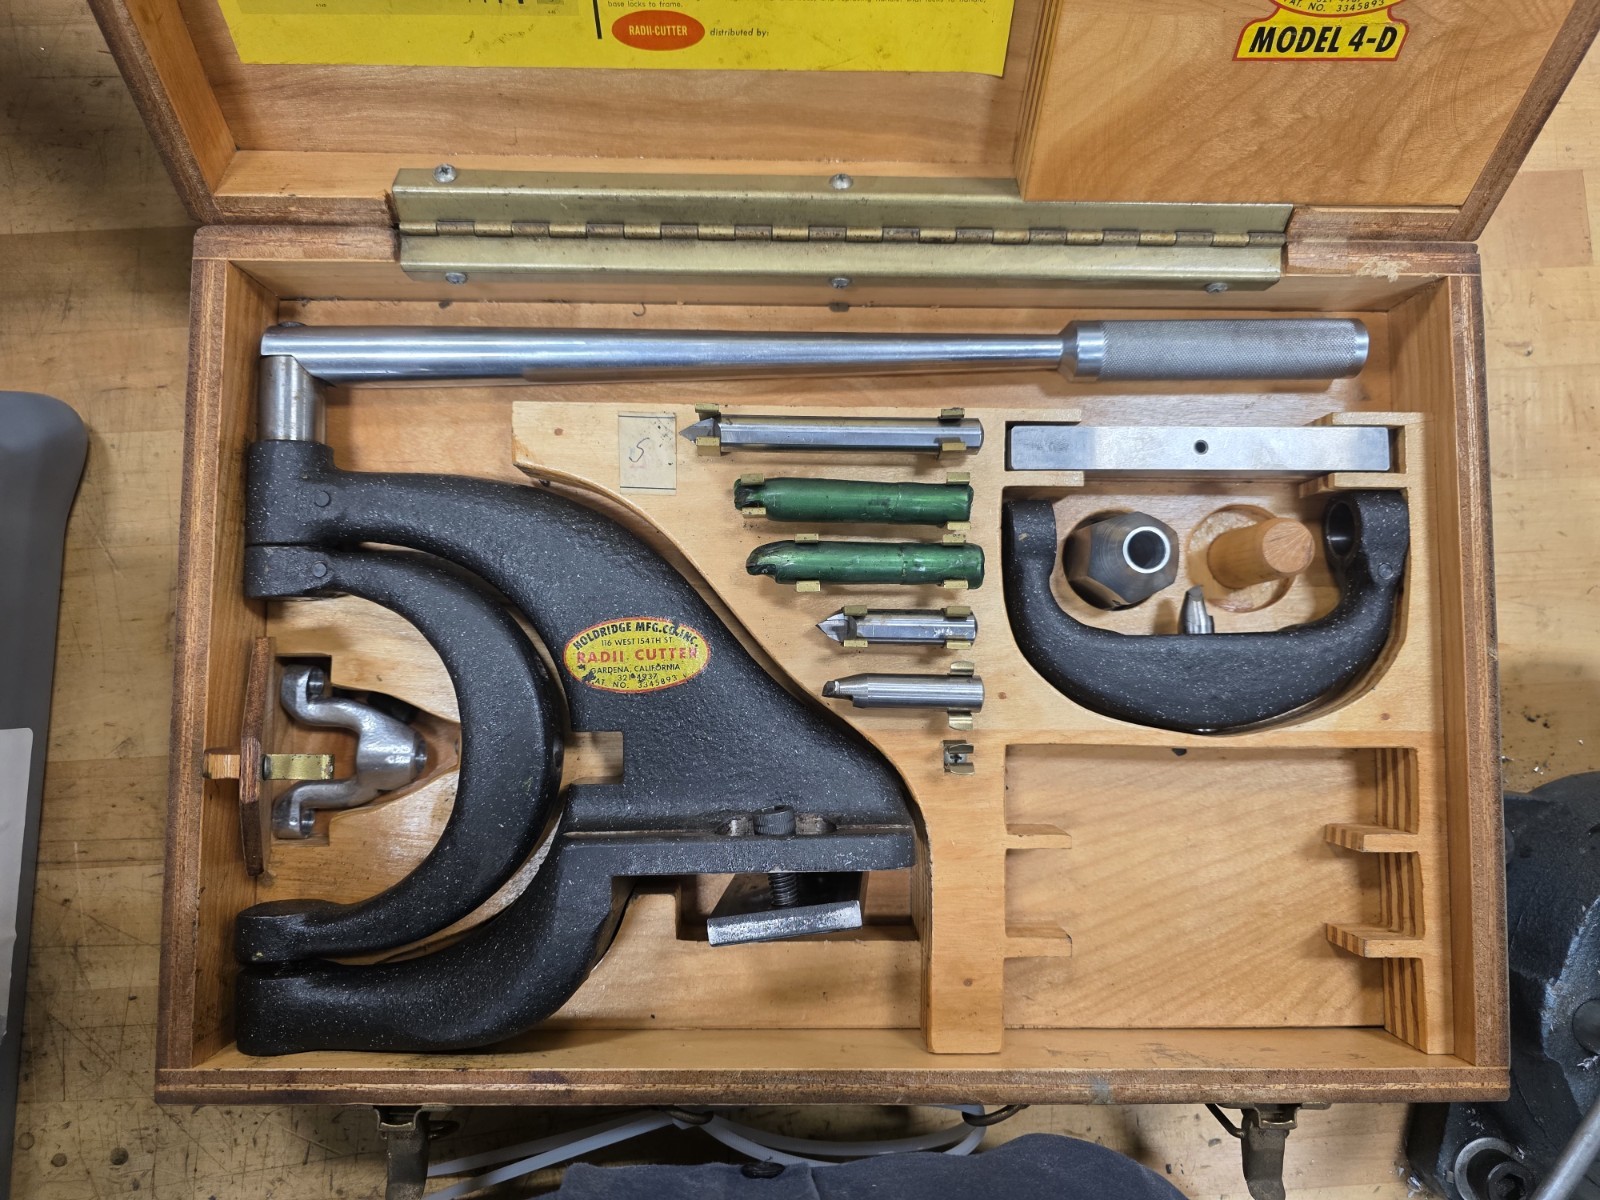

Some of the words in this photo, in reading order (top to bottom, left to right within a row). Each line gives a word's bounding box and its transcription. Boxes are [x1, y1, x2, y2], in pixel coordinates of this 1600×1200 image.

[1308, 2, 1326, 12] NO.
[1336, 0, 1385, 12] 3345893
[629, 25, 688, 36] RADII-CUTTER
[710, 27, 754, 37] distributed
[757, 28, 769, 38] by:
[1249, 26, 1342, 53] MODEL
[1348, 26, 1398, 53] 4-D
[573, 622, 632, 650] HOLDRIDGE
[615, 638, 635, 646] WEST
[637, 637, 661, 645] 154TH
[576, 651, 624, 663] RADII
[634, 647, 698, 660] CUTTER
[590, 666, 632, 674] GARDENA,
[634, 663, 680, 672] CALIFORNIA
[591, 675, 607, 686] AT.
[638, 675, 678, 689] 3345893
[617, 673, 658, 681] 3214937
